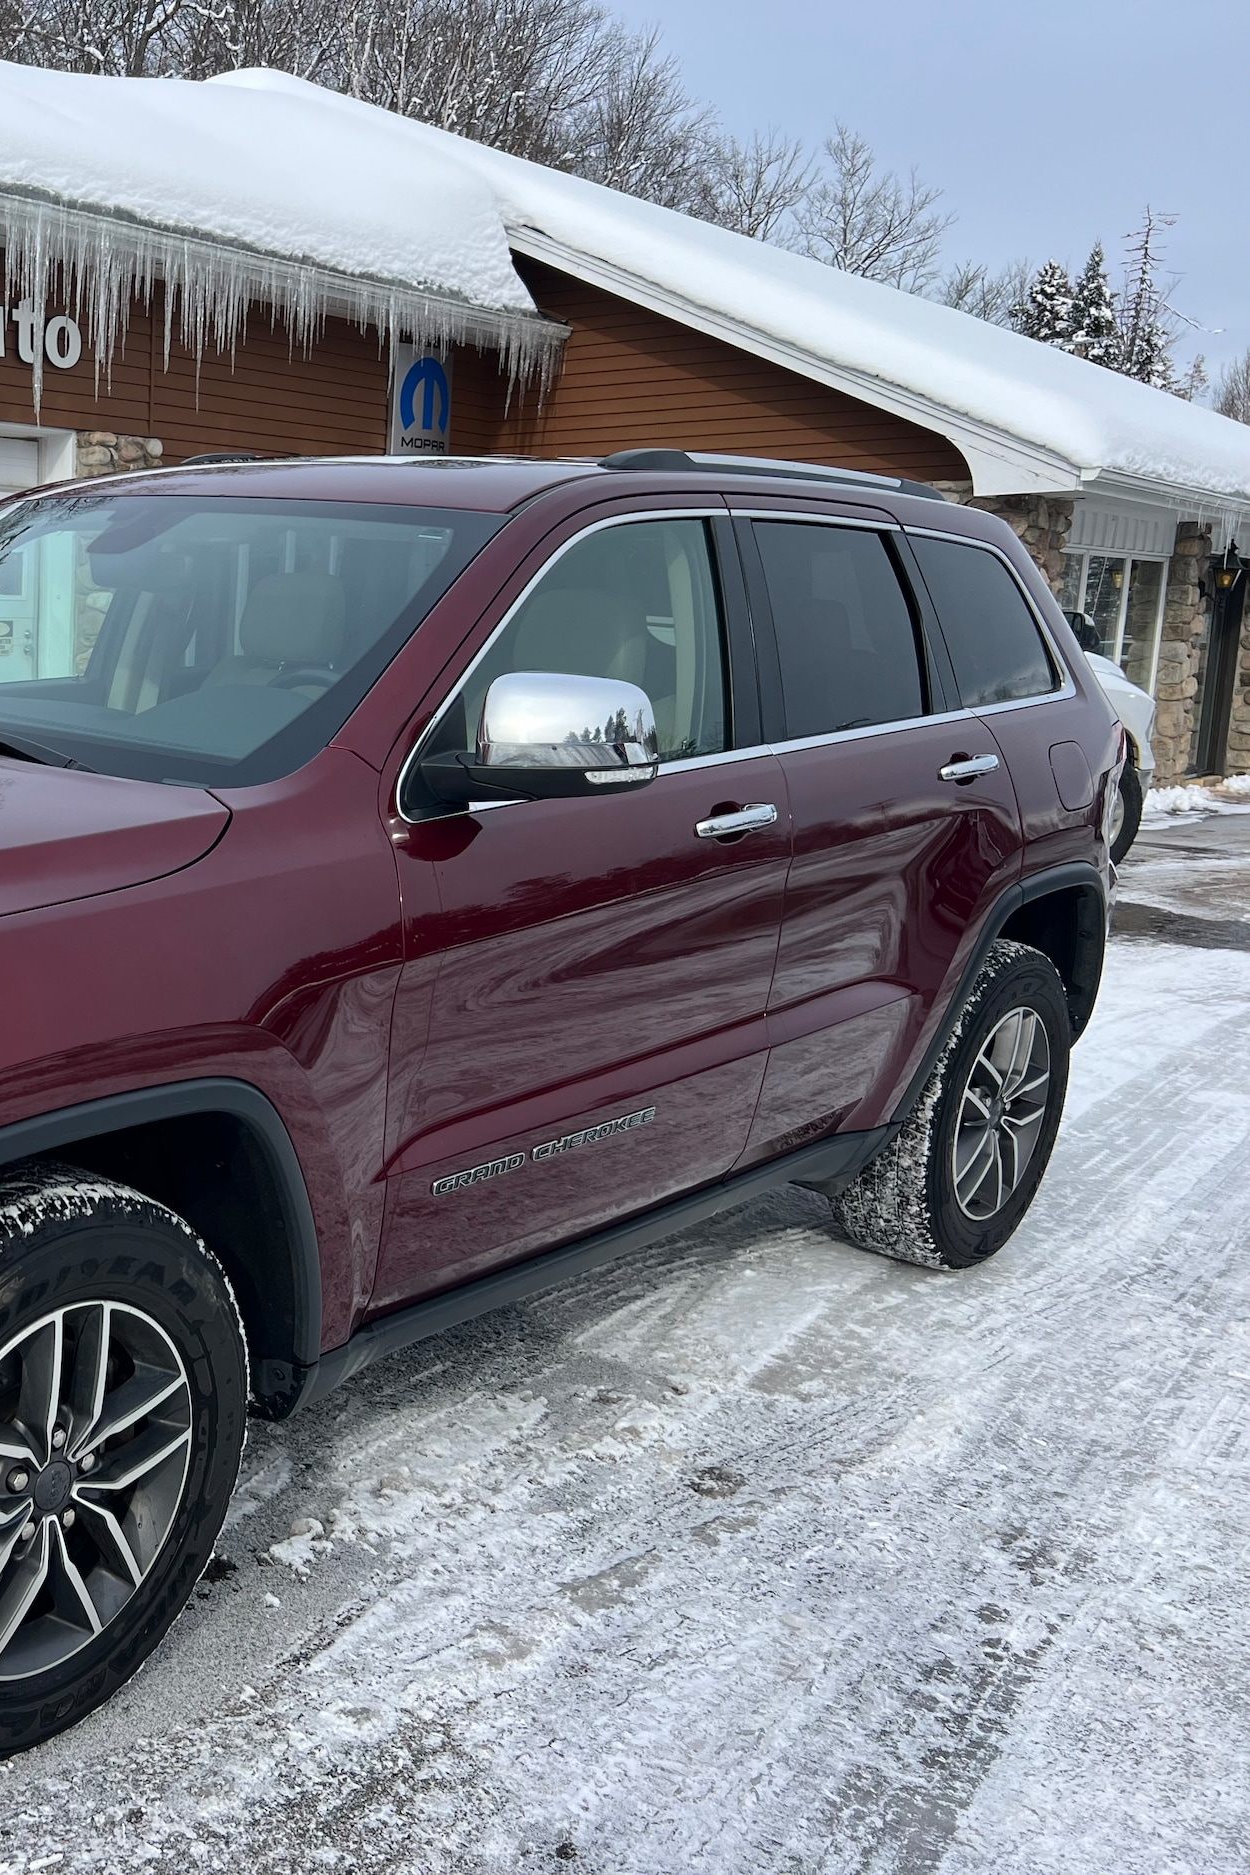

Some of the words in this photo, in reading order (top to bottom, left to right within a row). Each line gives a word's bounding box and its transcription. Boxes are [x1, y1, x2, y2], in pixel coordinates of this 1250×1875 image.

[400, 436, 446, 453] MOPAR
[432, 1152, 526, 1197] GRAND
[530, 1106, 657, 1162] CHEROKEE
